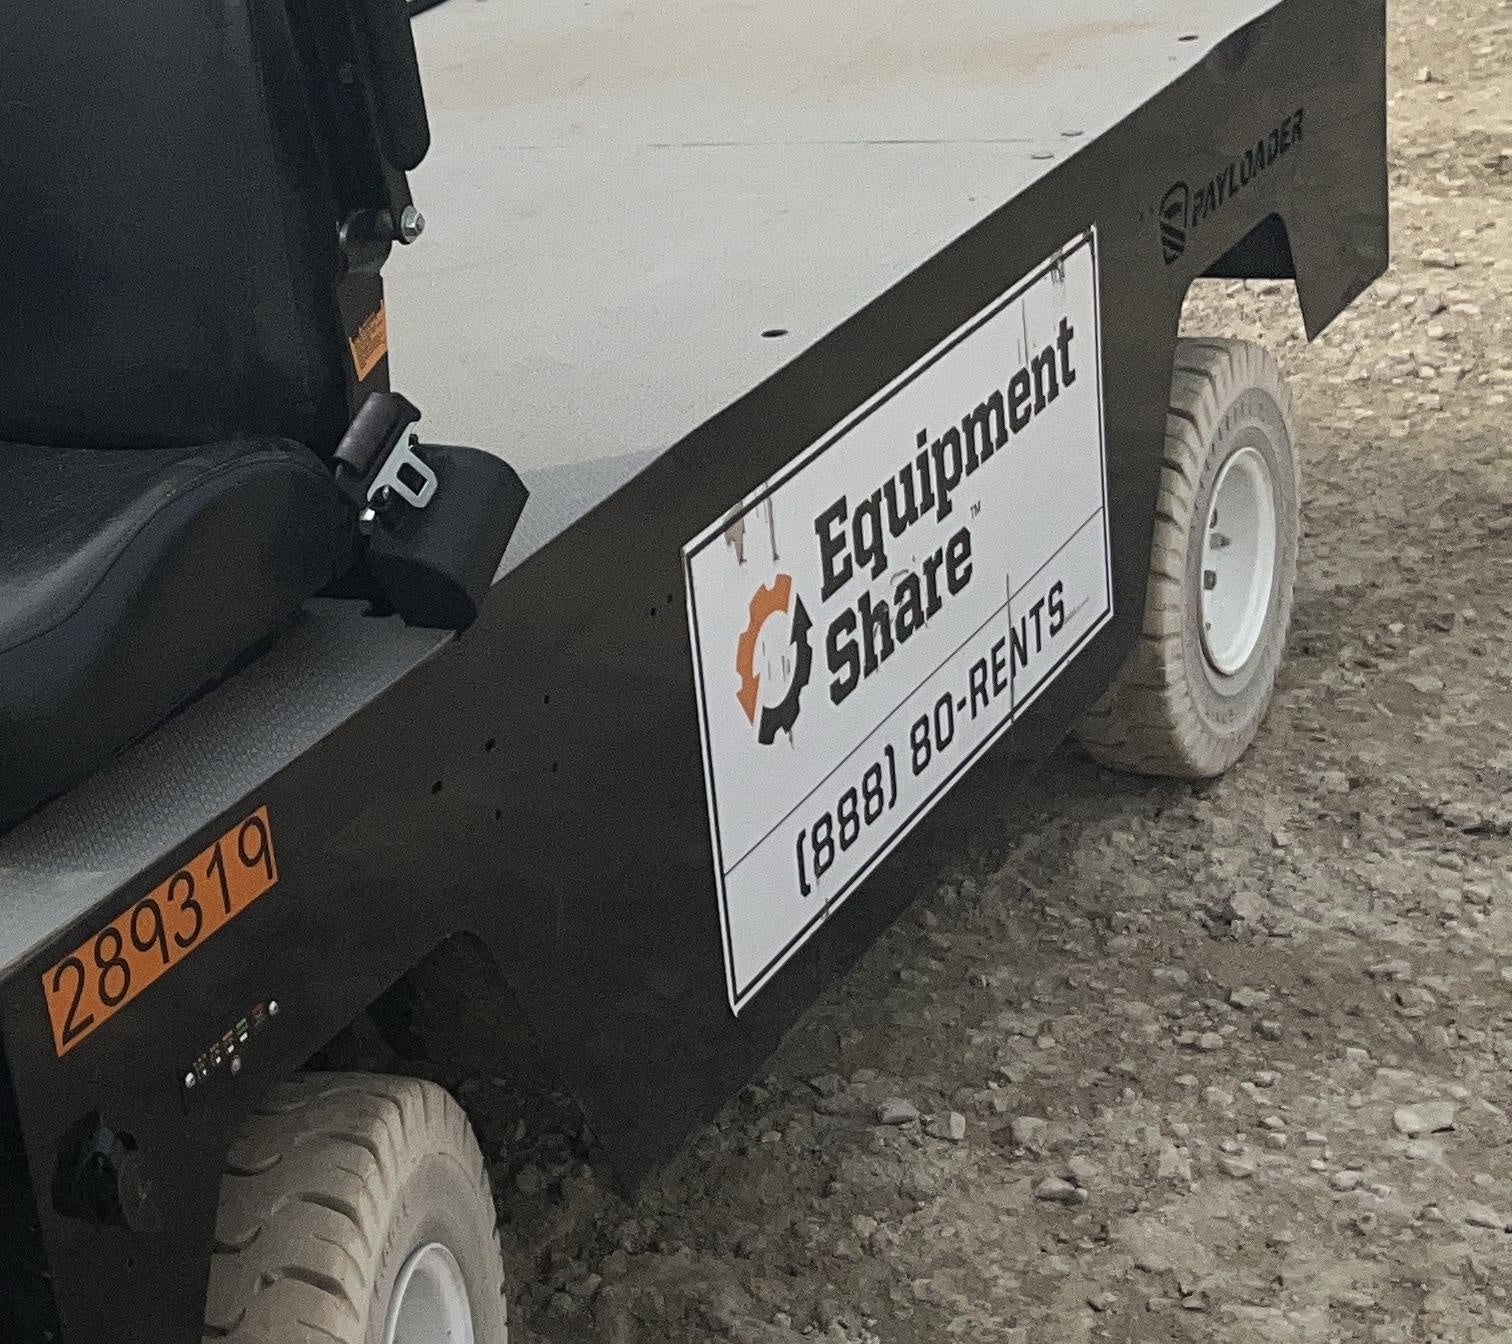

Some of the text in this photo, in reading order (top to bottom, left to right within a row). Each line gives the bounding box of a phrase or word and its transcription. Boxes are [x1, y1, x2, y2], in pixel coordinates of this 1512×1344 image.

[814, 316, 1076, 603] Equipment
[796, 580, 1065, 897] (888) 80-RENTS
[52, 815, 274, 1047] 289319
